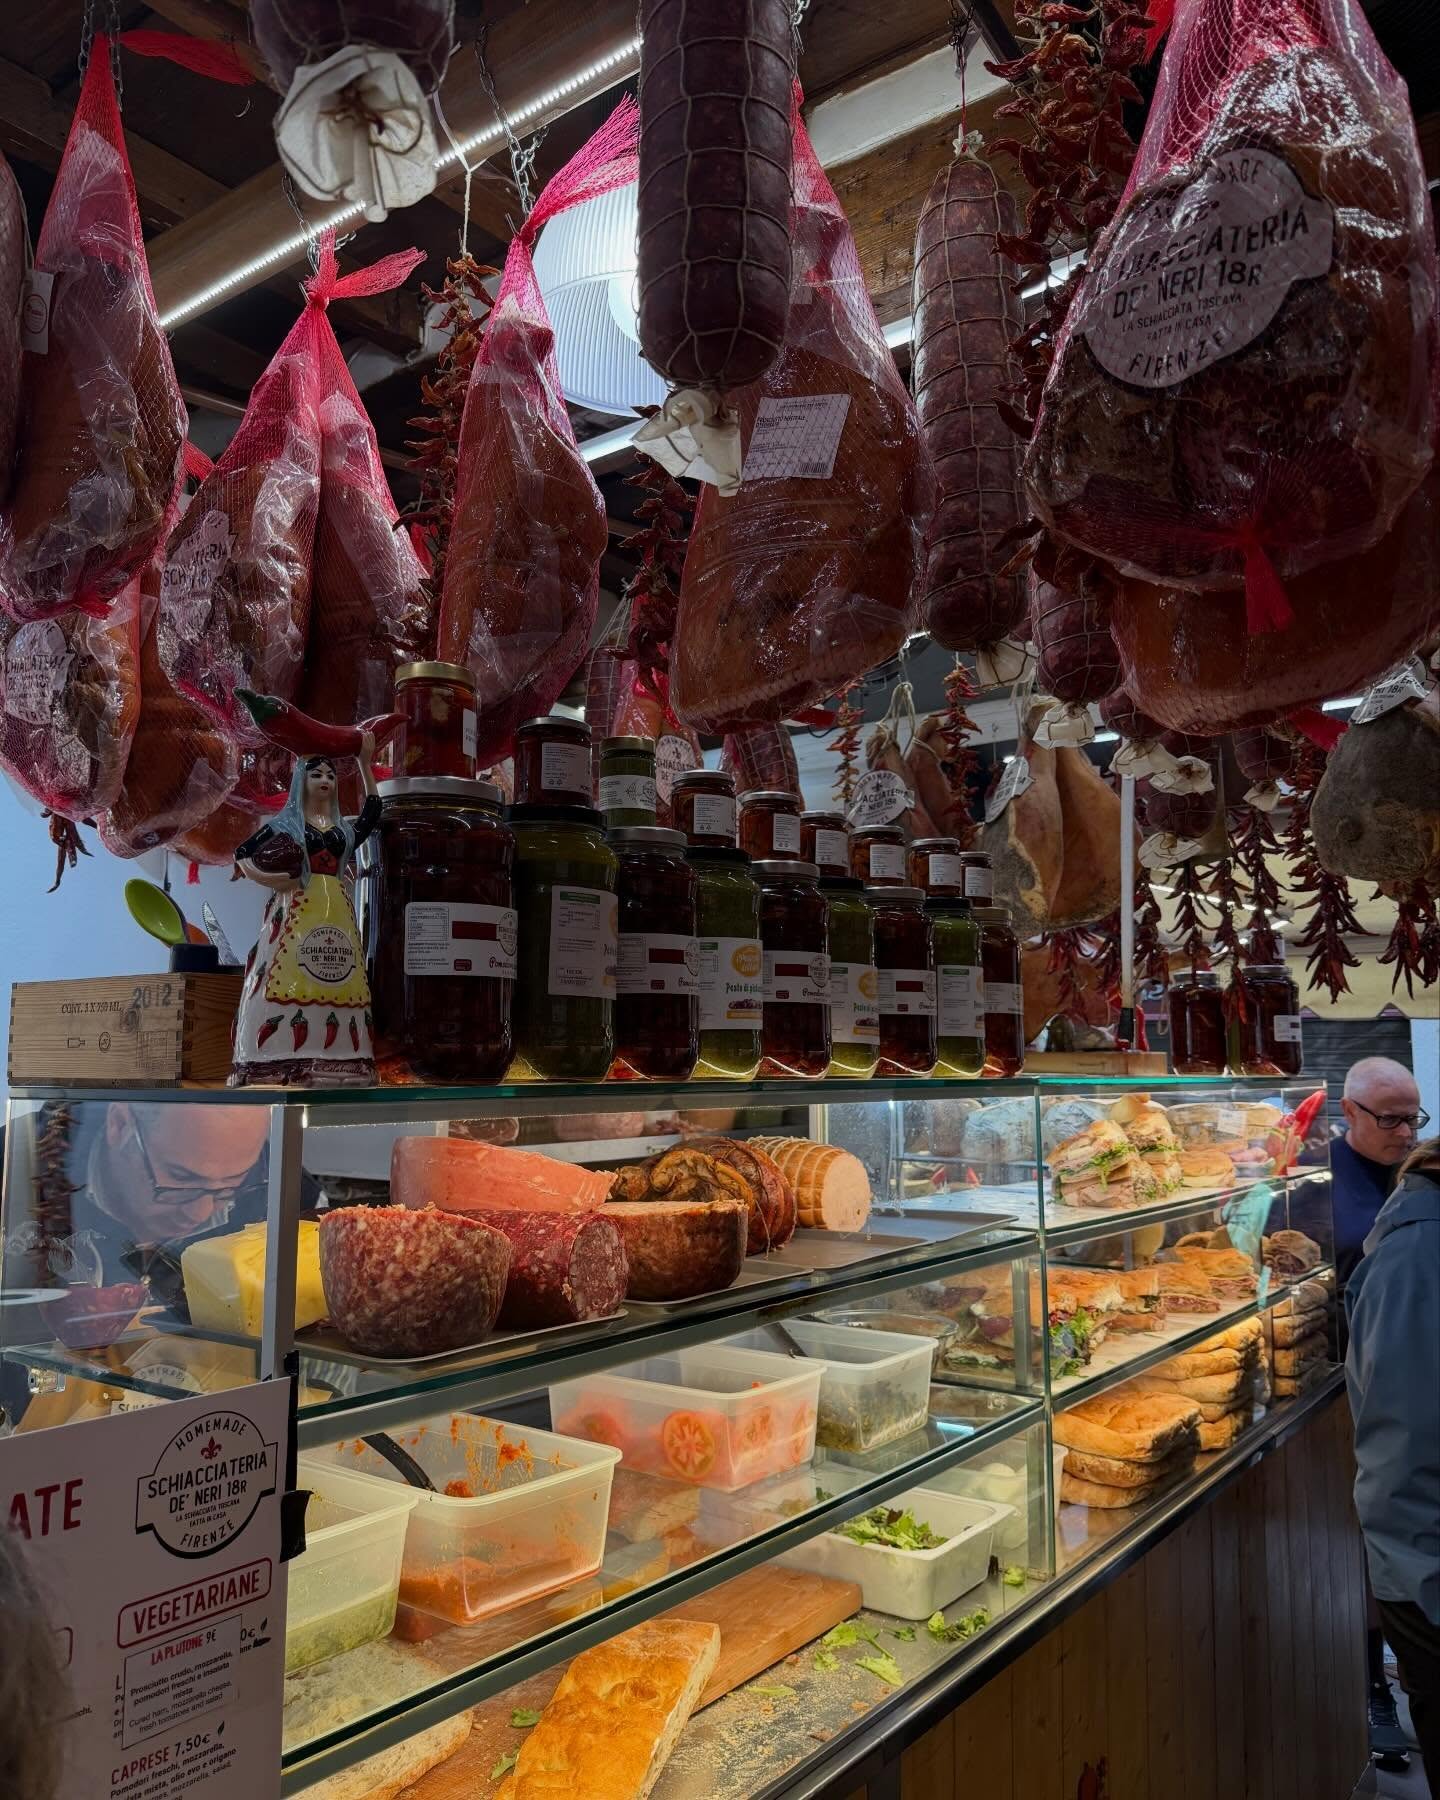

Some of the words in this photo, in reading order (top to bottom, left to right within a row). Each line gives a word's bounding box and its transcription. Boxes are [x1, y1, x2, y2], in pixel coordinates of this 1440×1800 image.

[1158, 260, 1205, 303] NERI
[1217, 260, 1262, 287] 18R
[300, 946, 353, 956] SCHIACCIATERIA
[132, 983, 173, 1009] 2012
[175, 1417, 247, 1451] HOMEMADE
[148, 1451, 267, 1499] SCHIACCIATERIA
[8, 1478, 83, 1539] ATE
[169, 1493, 190, 1514] DE'
[195, 1484, 221, 1506] NERI
[227, 1479, 247, 1497] 18R
[184, 1504, 217, 1521] SCHIACCIATA
[212, 1511, 226, 1521] CASA
[180, 1519, 235, 1548] FIRENZE
[133, 1568, 261, 1635] VEGETARIANE
[151, 1648, 163, 1665] LA
[164, 1634, 203, 1659] PLUTONE
[206, 1629, 217, 1644] 9€
[130, 1676, 169, 1697] Prosciutto
[170, 1666, 193, 1683] crudo,
[194, 1650, 233, 1671] mozzarella,
[134, 1687, 170, 1707] pomodori
[171, 1675, 196, 1693] freschi
[203, 1662, 230, 1678] insalata
[172, 1687, 193, 1699] mista
[129, 1712, 151, 1728] Cured
[171, 1691, 207, 1710] mozzarella
[139, 1720, 157, 1734] fresh
[158, 1706, 190, 1725] tomatoes
[191, 1700, 204, 1712] and
[205, 1693, 223, 1706] salad
[110, 1775, 149, 1799] Pomodori
[151, 1762, 181, 1780] freschi,
[182, 1743, 225, 1766] mozzarella,
[111, 1746, 169, 1786] CAPRESE
[175, 1733, 210, 1757] 7.50€
[144, 1781, 168, 1796] mista,
[170, 1772, 185, 1784] olio
[187, 1765, 201, 1776] evo
[209, 1748, 237, 1766] origano
